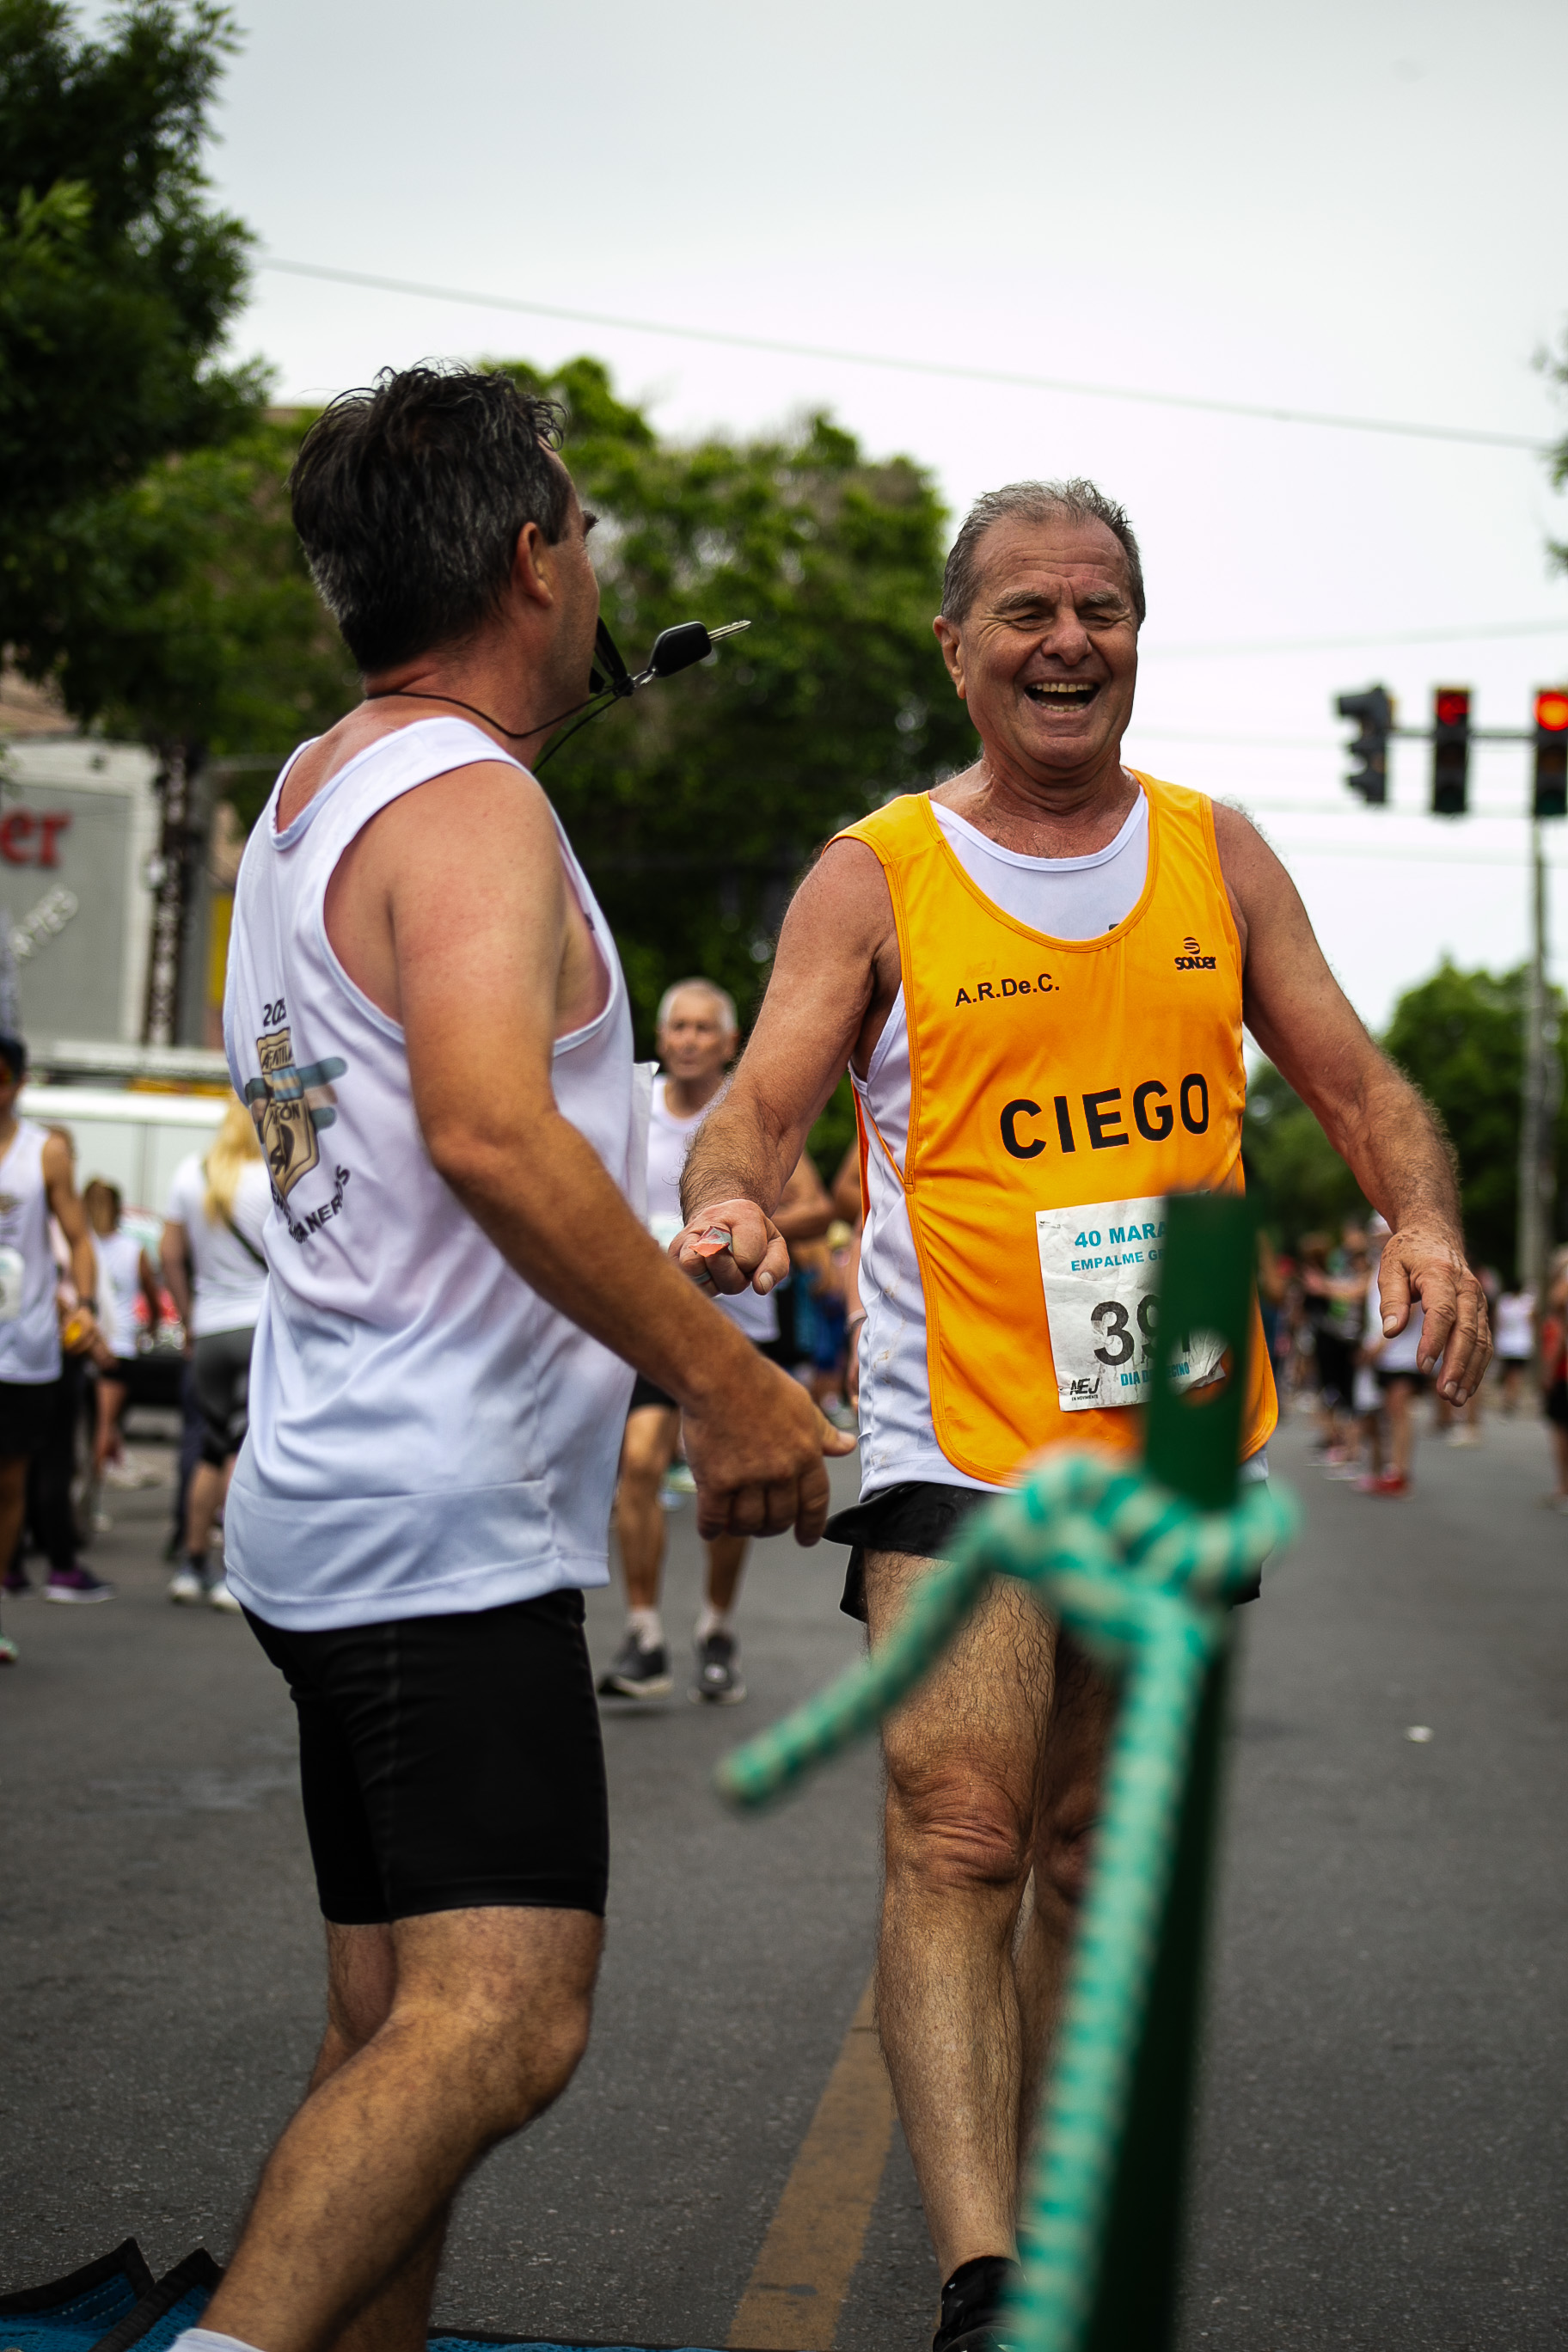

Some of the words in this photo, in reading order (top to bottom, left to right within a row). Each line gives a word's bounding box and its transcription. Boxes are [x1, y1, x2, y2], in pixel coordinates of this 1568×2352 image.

[954, 972, 1060, 1008] A.R.De.C.
[1000, 1073, 1210, 1160] CIEGO
[1075, 1230, 1101, 1248] 40
[1070, 1251, 1144, 1271] EMPALME
[1120, 1371, 1141, 1387] DIA
